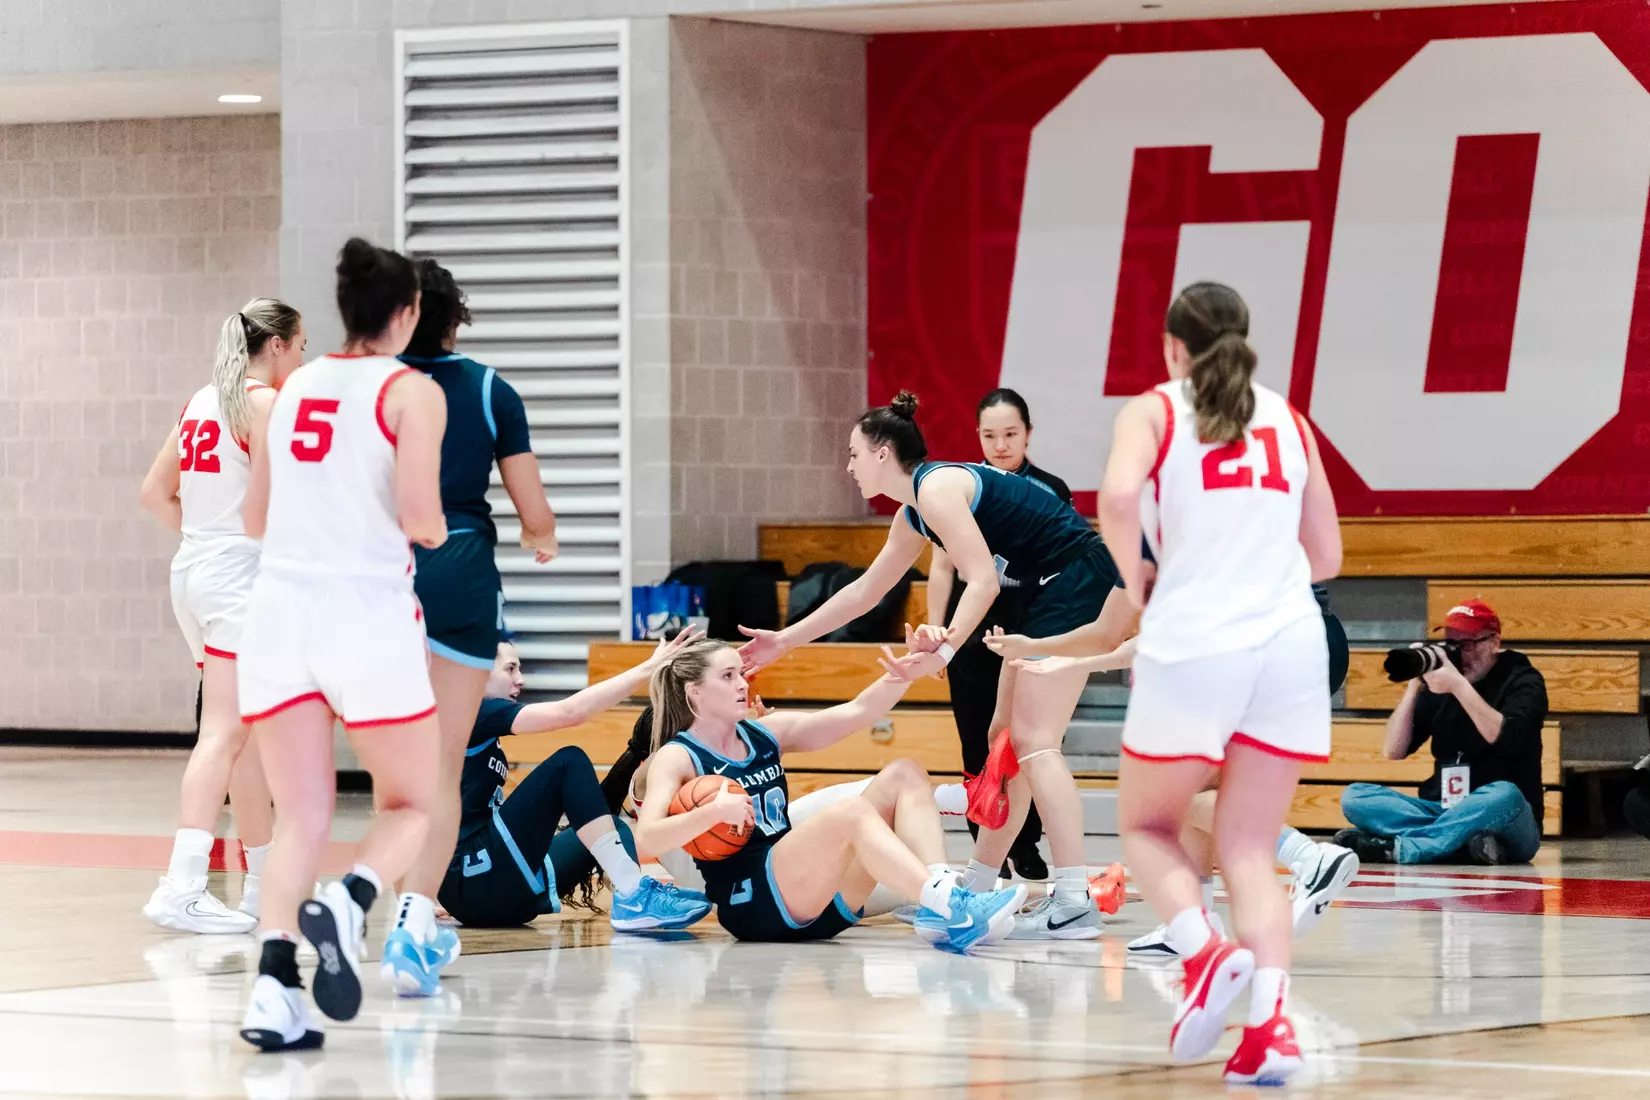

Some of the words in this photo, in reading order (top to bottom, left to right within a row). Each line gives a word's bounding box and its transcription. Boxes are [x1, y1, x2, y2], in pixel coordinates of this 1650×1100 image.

[998, 32, 1650, 491] GO
[179, 419, 221, 473] 32
[290, 398, 341, 462] 5
[1201, 427, 1290, 494] 21
[1448, 776, 1463, 795] C
